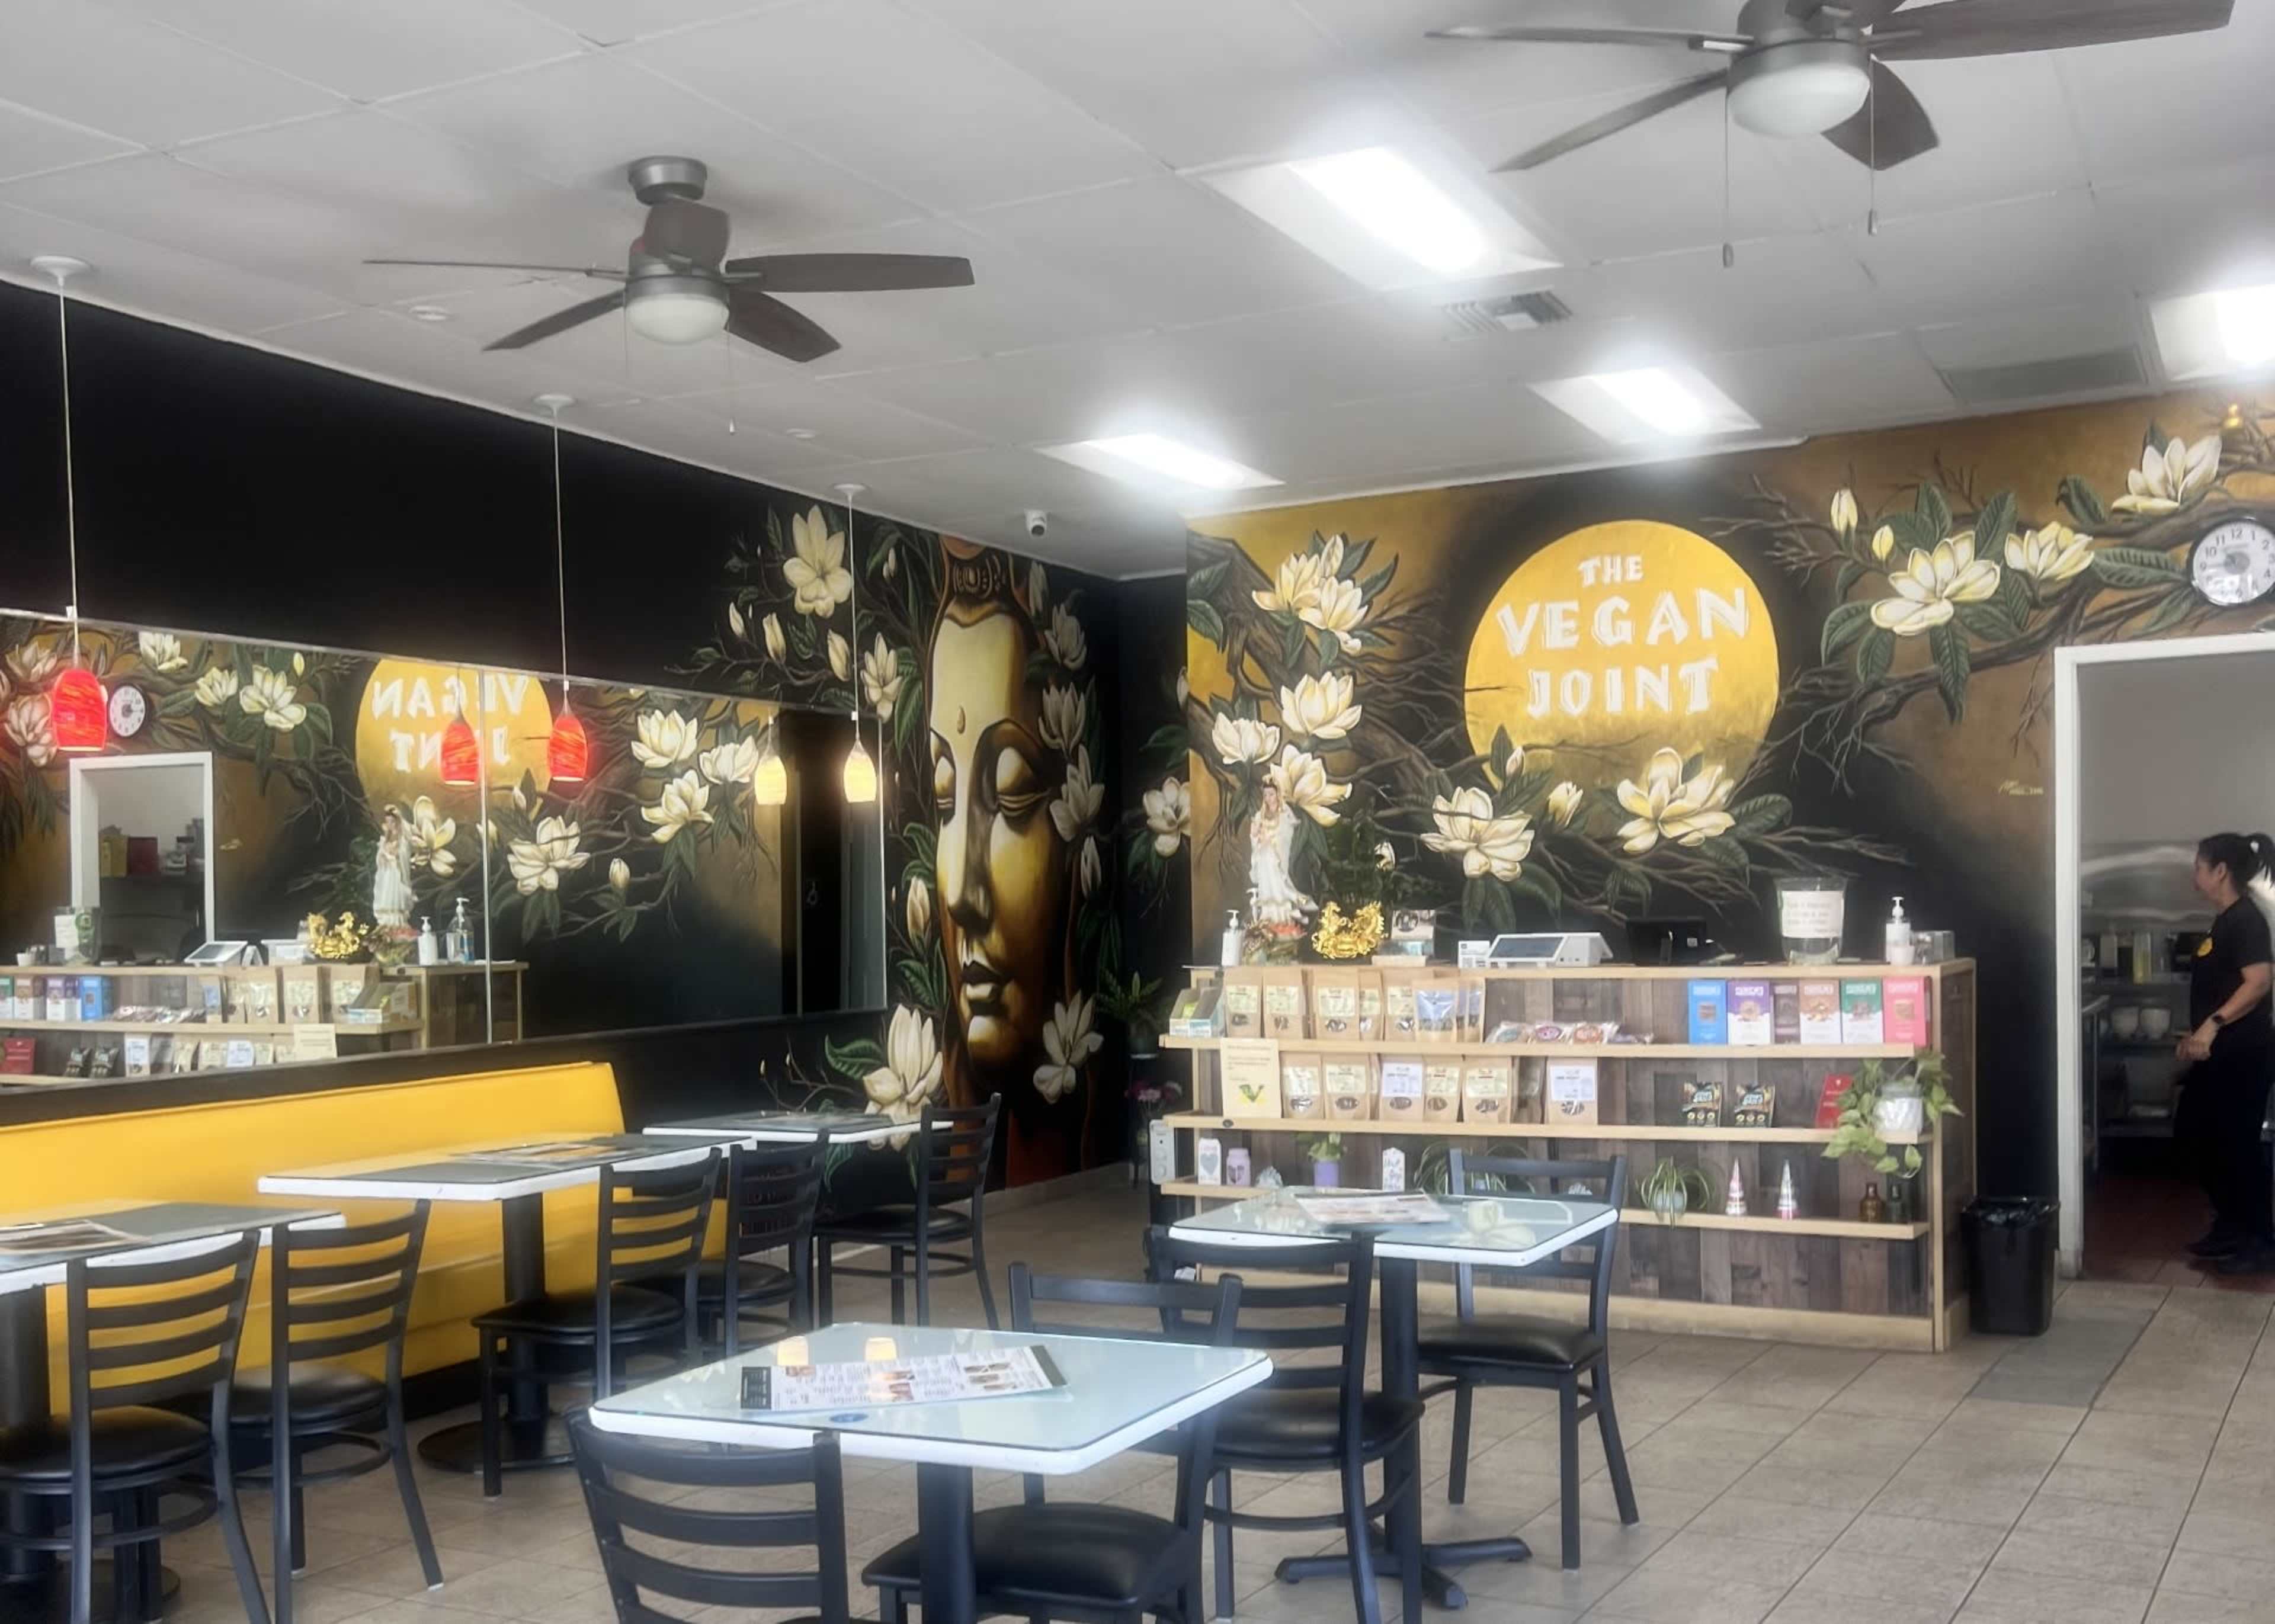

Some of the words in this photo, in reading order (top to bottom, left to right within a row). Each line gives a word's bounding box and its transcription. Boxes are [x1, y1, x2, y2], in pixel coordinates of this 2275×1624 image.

[2216, 533, 2225, 546] 11
[2231, 528, 2242, 540] 12
[2205, 547, 2217, 559] 10
[1577, 554, 1643, 587] THE
[1497, 587, 1749, 657] VEGAN
[1527, 657, 1718, 718] JOINT
